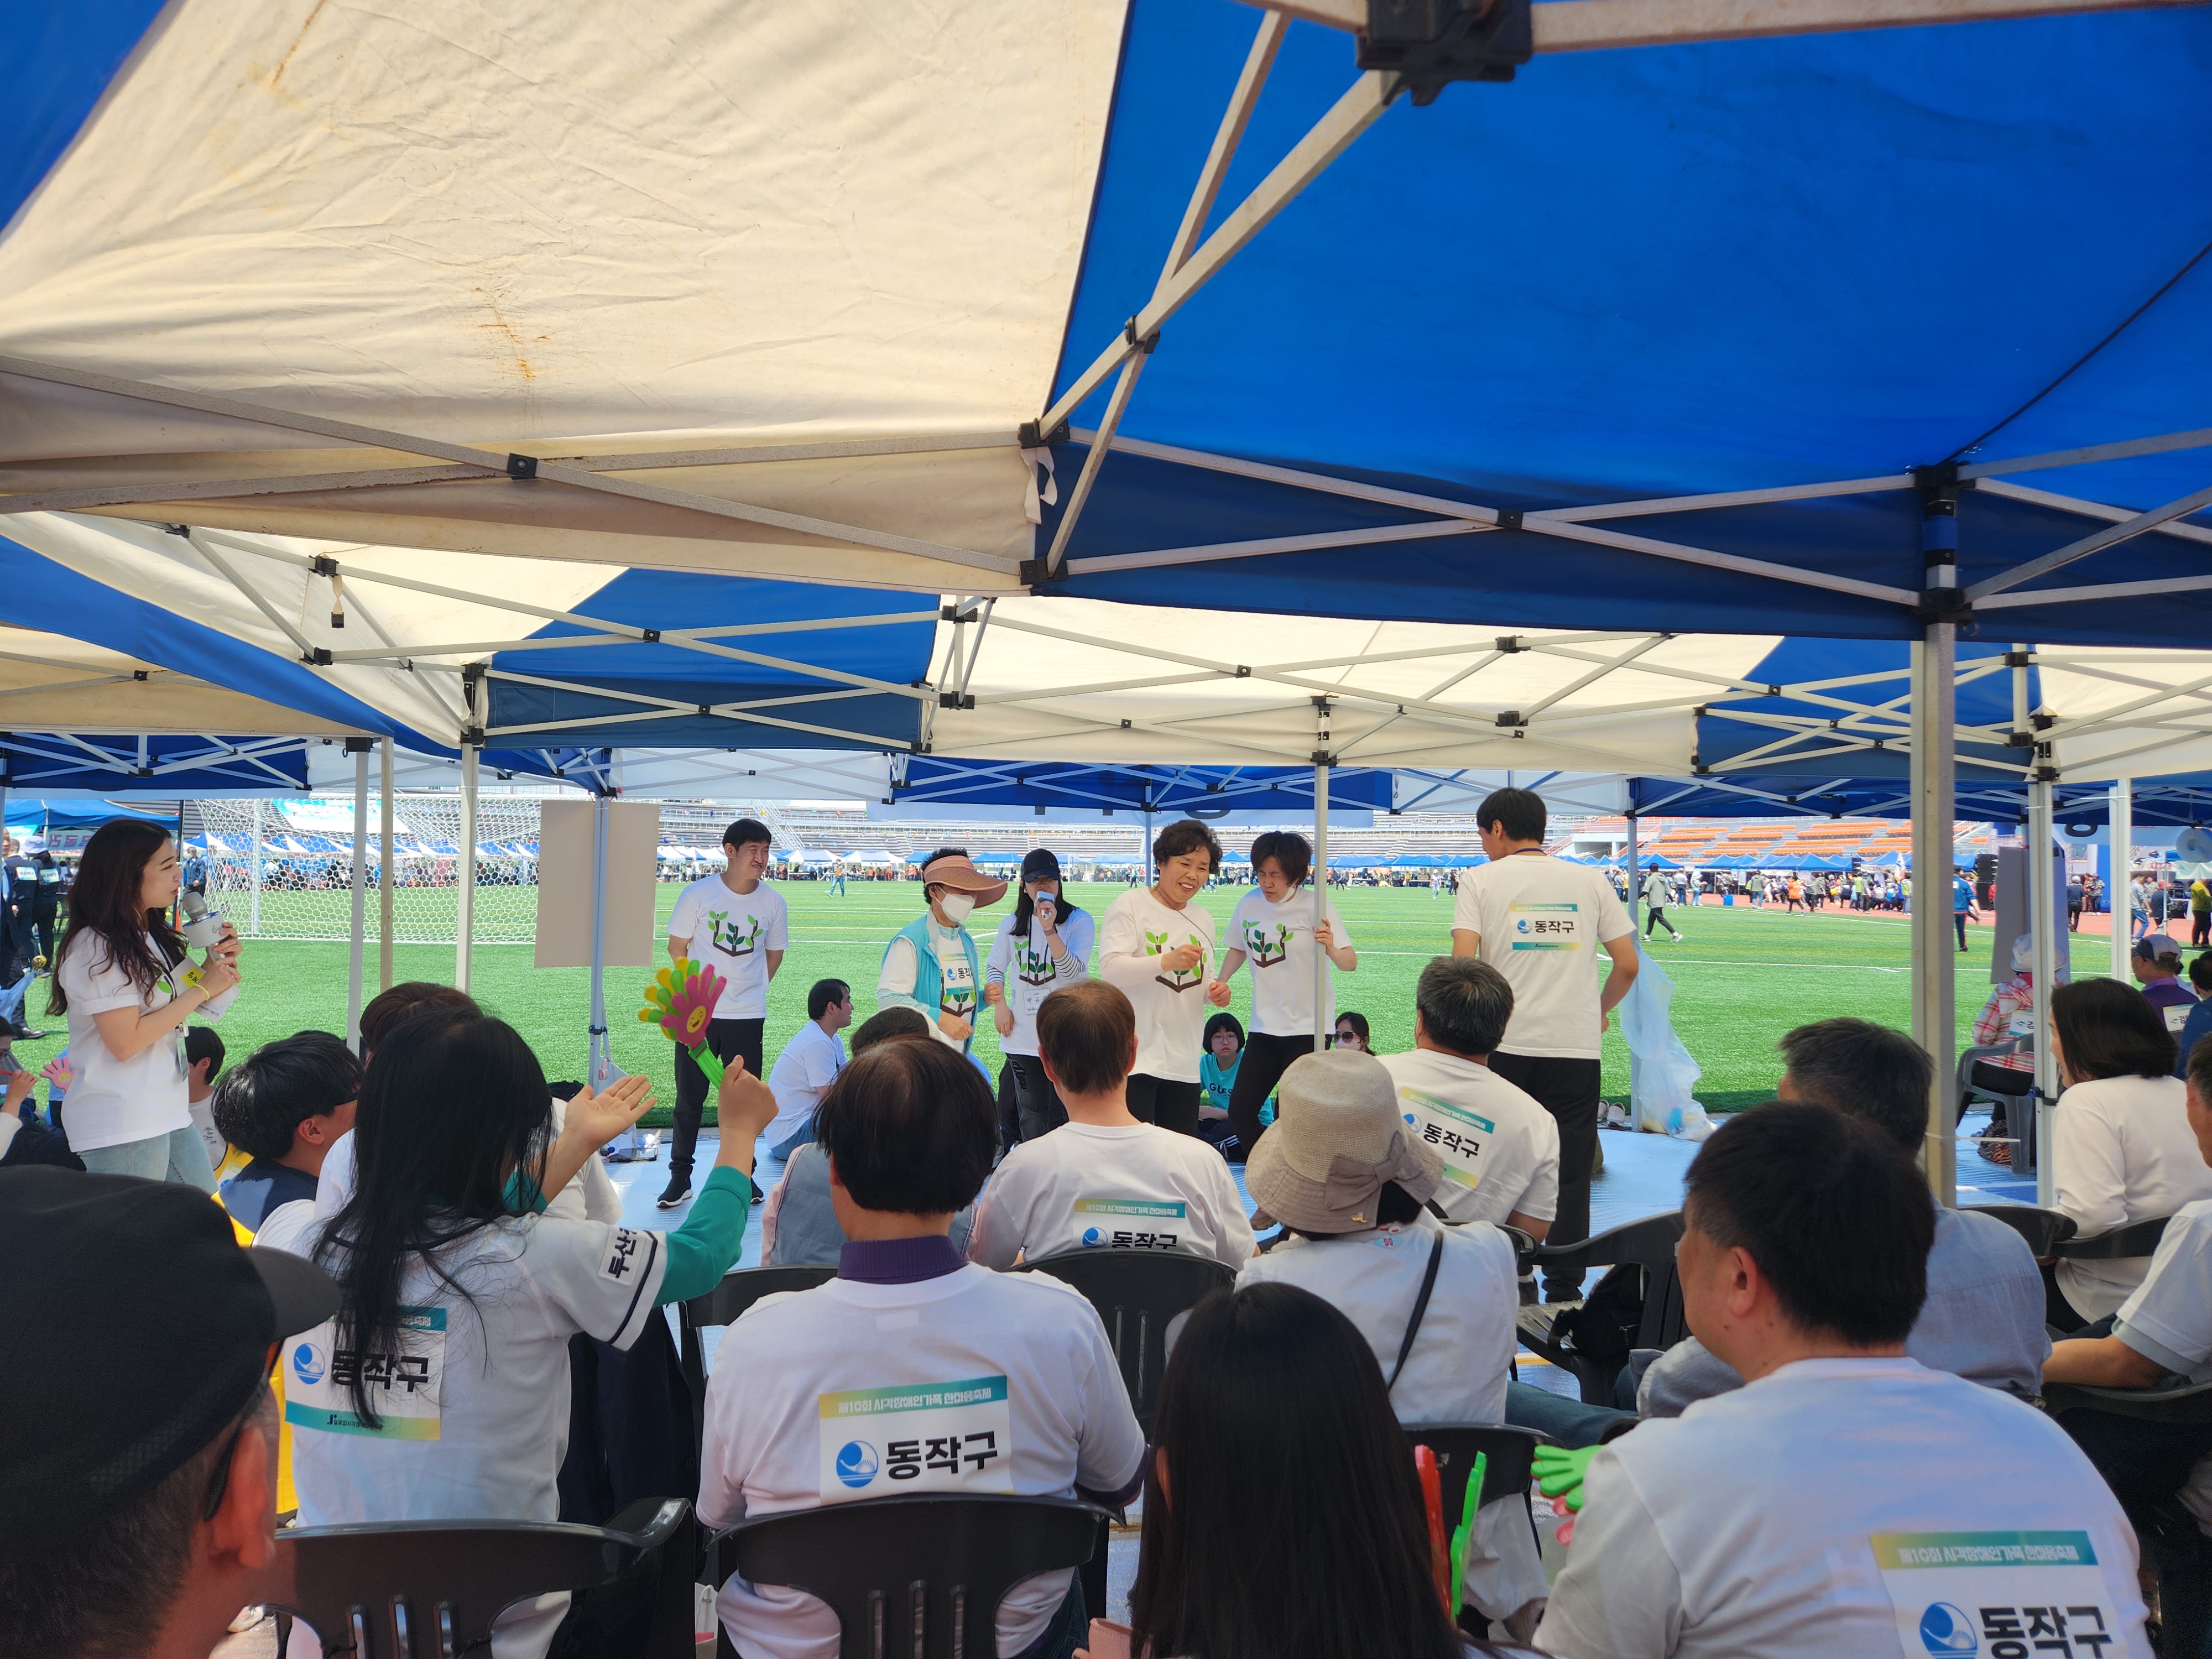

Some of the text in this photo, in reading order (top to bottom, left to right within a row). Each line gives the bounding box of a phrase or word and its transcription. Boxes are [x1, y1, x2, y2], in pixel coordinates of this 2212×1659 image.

[1535, 920, 1574, 933] 동작구
[1423, 1123, 1480, 1159] 동작구
[608, 1228, 637, 1279] 두산
[1112, 1231, 1177, 1250] 동작구
[331, 1350, 429, 1392] 동작구
[838, 1399, 872, 1414] 제10회
[943, 1387, 992, 1405] 한마음축제
[886, 1431, 998, 1480] 동작구
[1897, 1546, 1941, 1564] 제10회
[1978, 1606, 2113, 1659] 동작구
